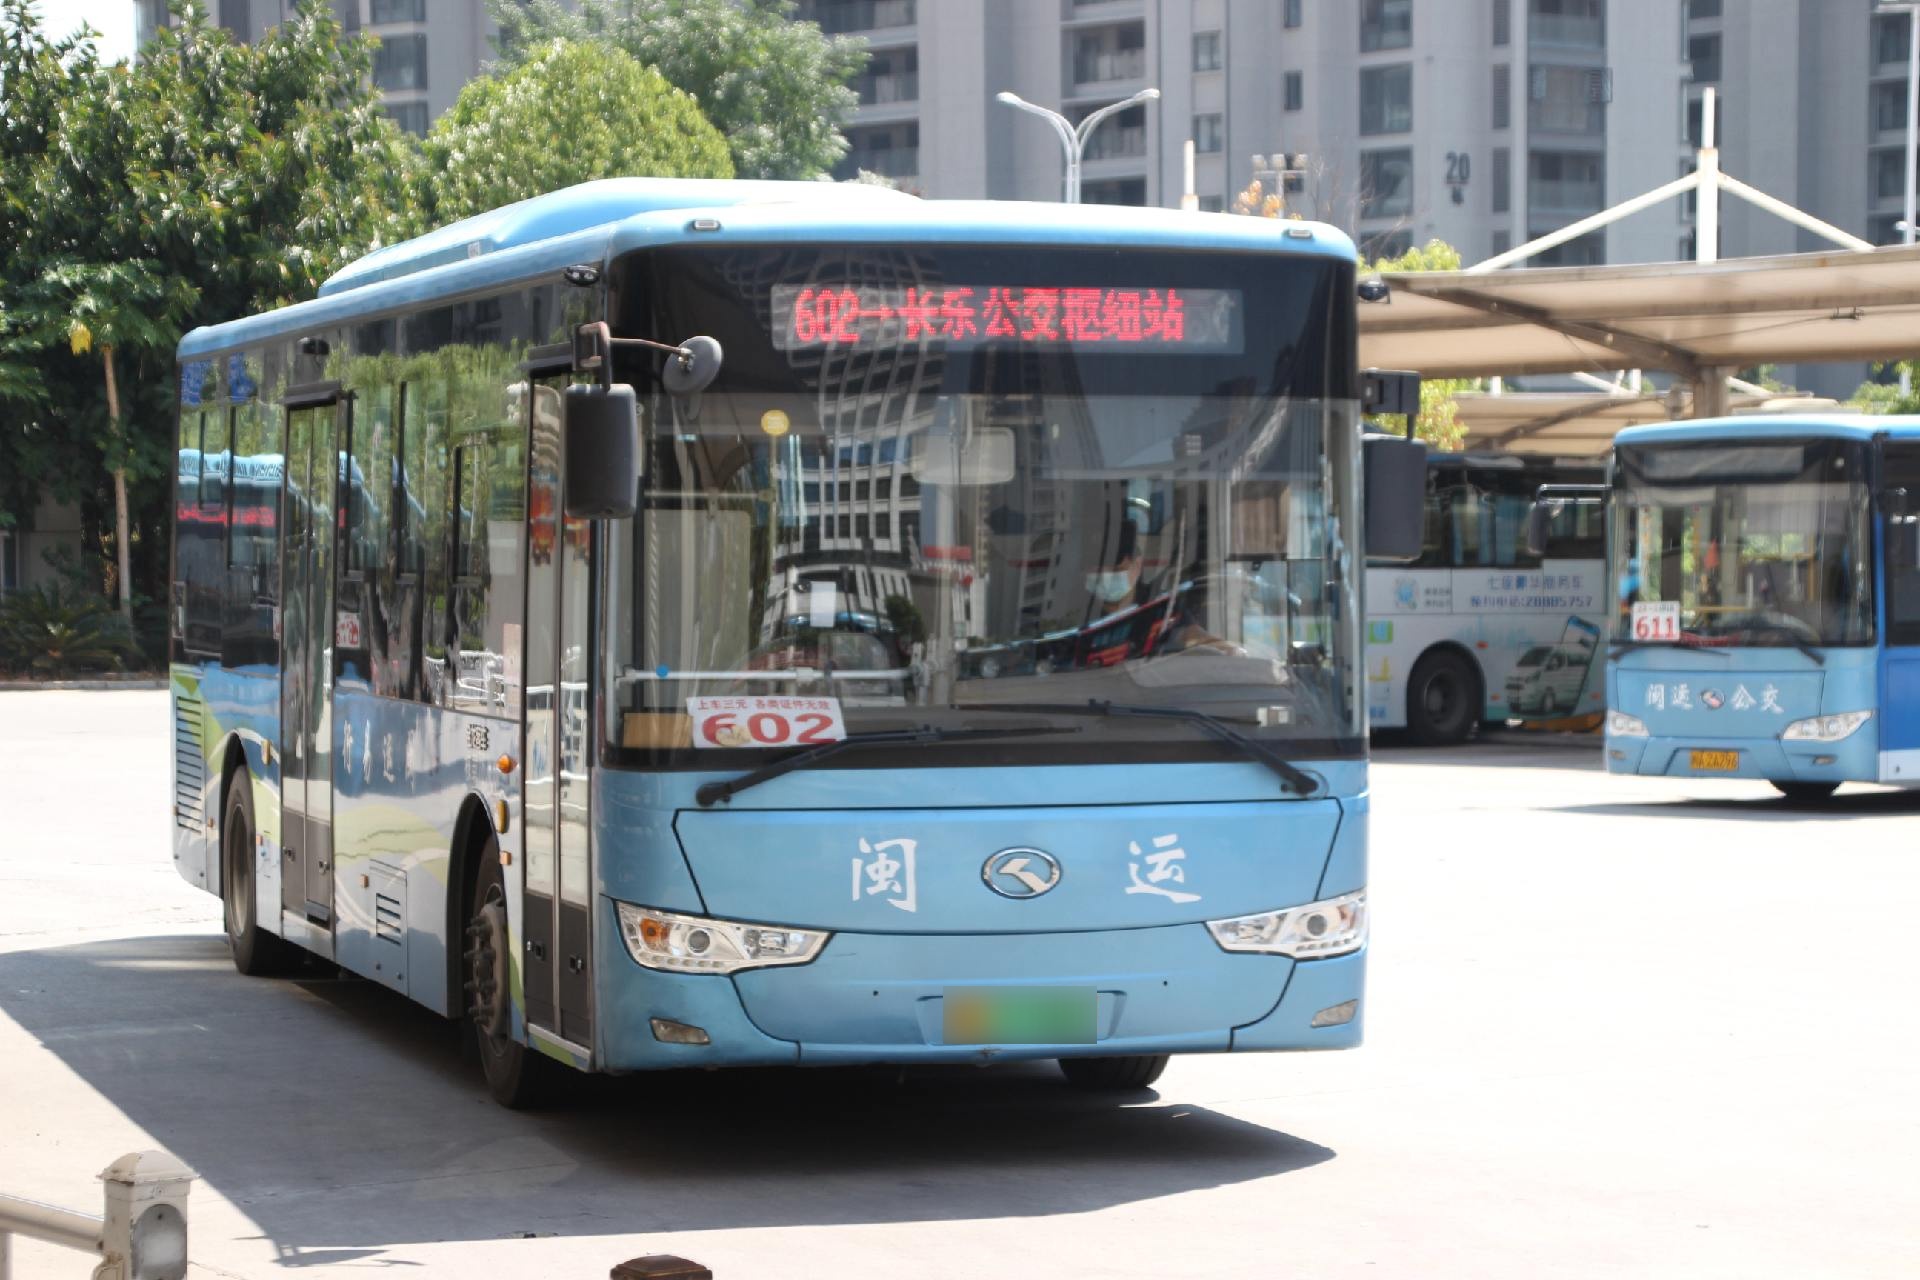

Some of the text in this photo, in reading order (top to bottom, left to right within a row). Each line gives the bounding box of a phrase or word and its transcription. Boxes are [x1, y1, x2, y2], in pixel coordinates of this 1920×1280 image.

[1446, 152, 1471, 183] 20
[795, 287, 859, 342] 602
[1636, 614, 1675, 641] 611
[702, 712, 837, 746] 602
